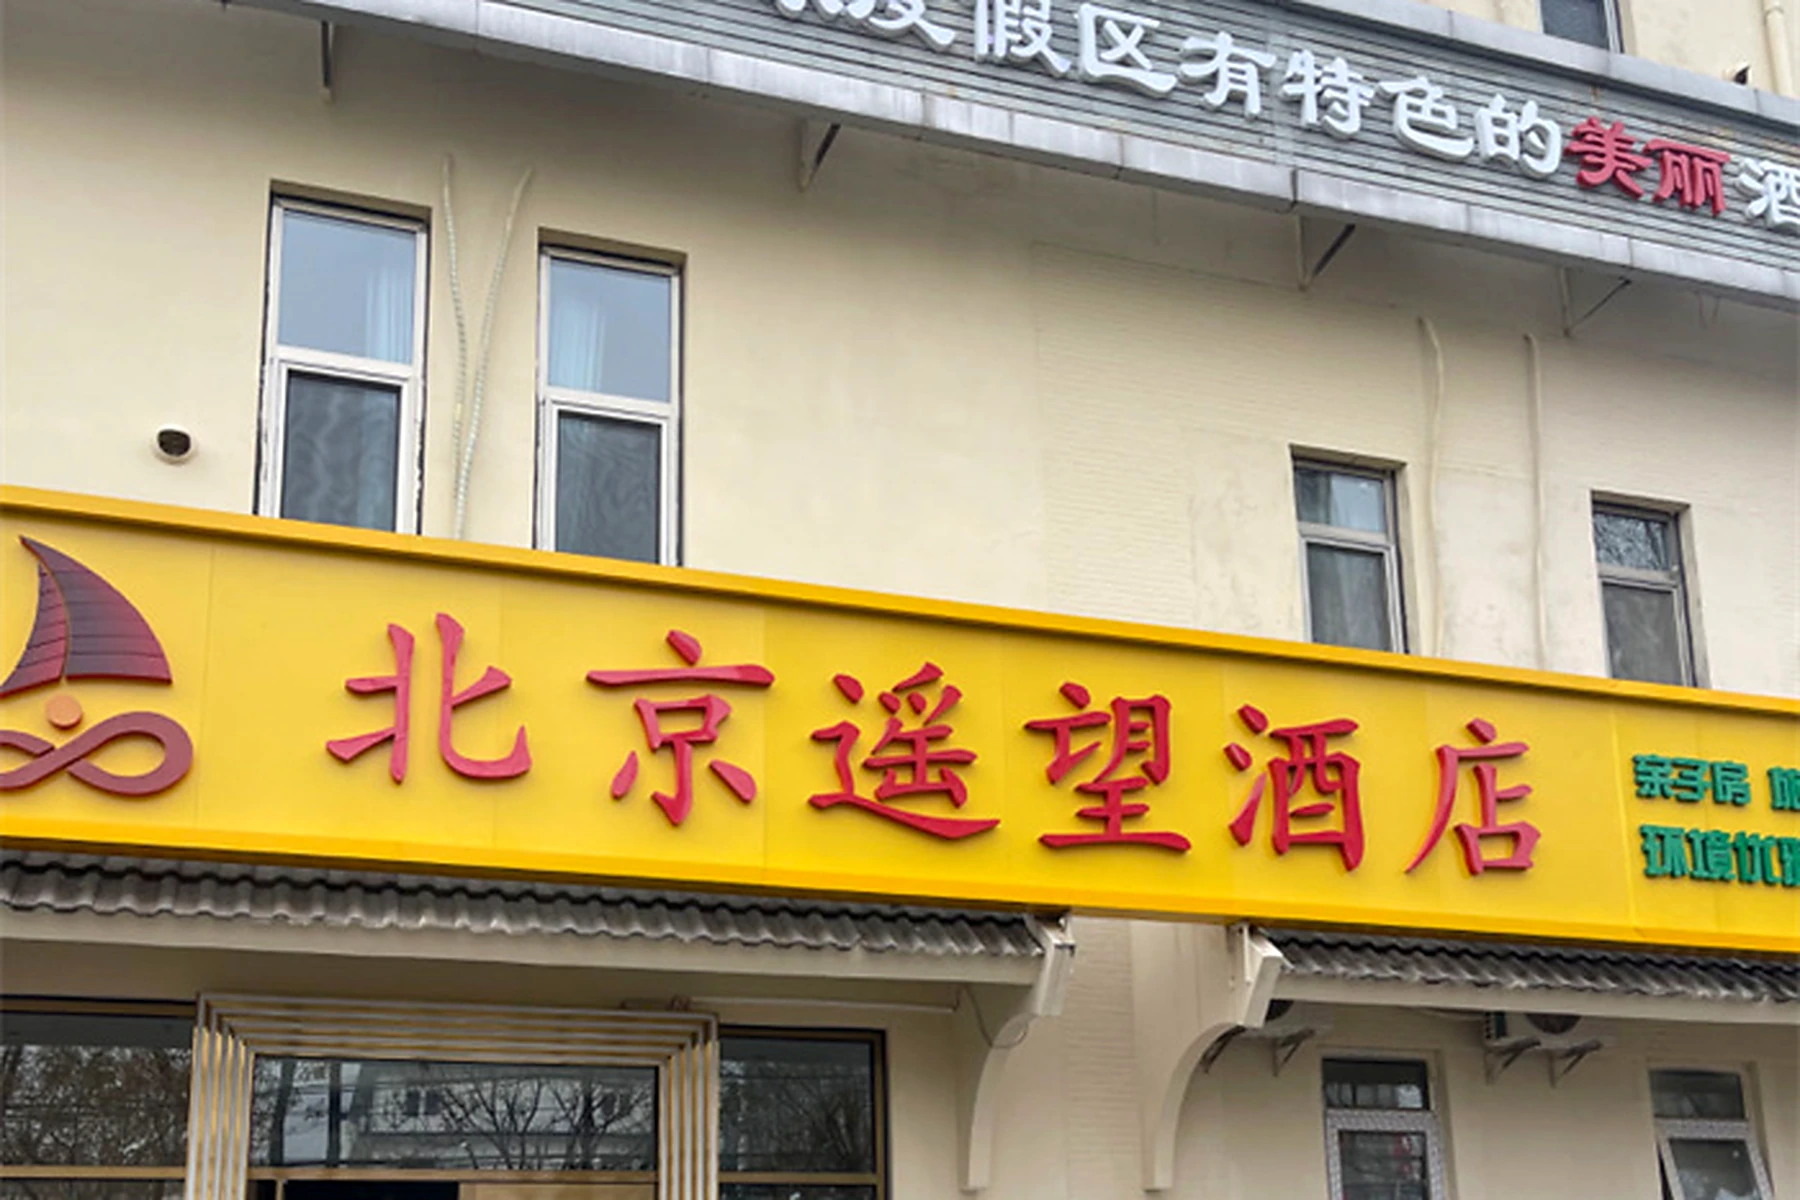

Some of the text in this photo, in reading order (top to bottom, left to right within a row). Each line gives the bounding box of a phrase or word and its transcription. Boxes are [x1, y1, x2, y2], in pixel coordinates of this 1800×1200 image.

[774, 0, 1800, 235] 假区有特色的美丽酒
[327, 612, 1541, 876] 北京遥望酒店
[1634, 754, 1751, 805] 亲子房
